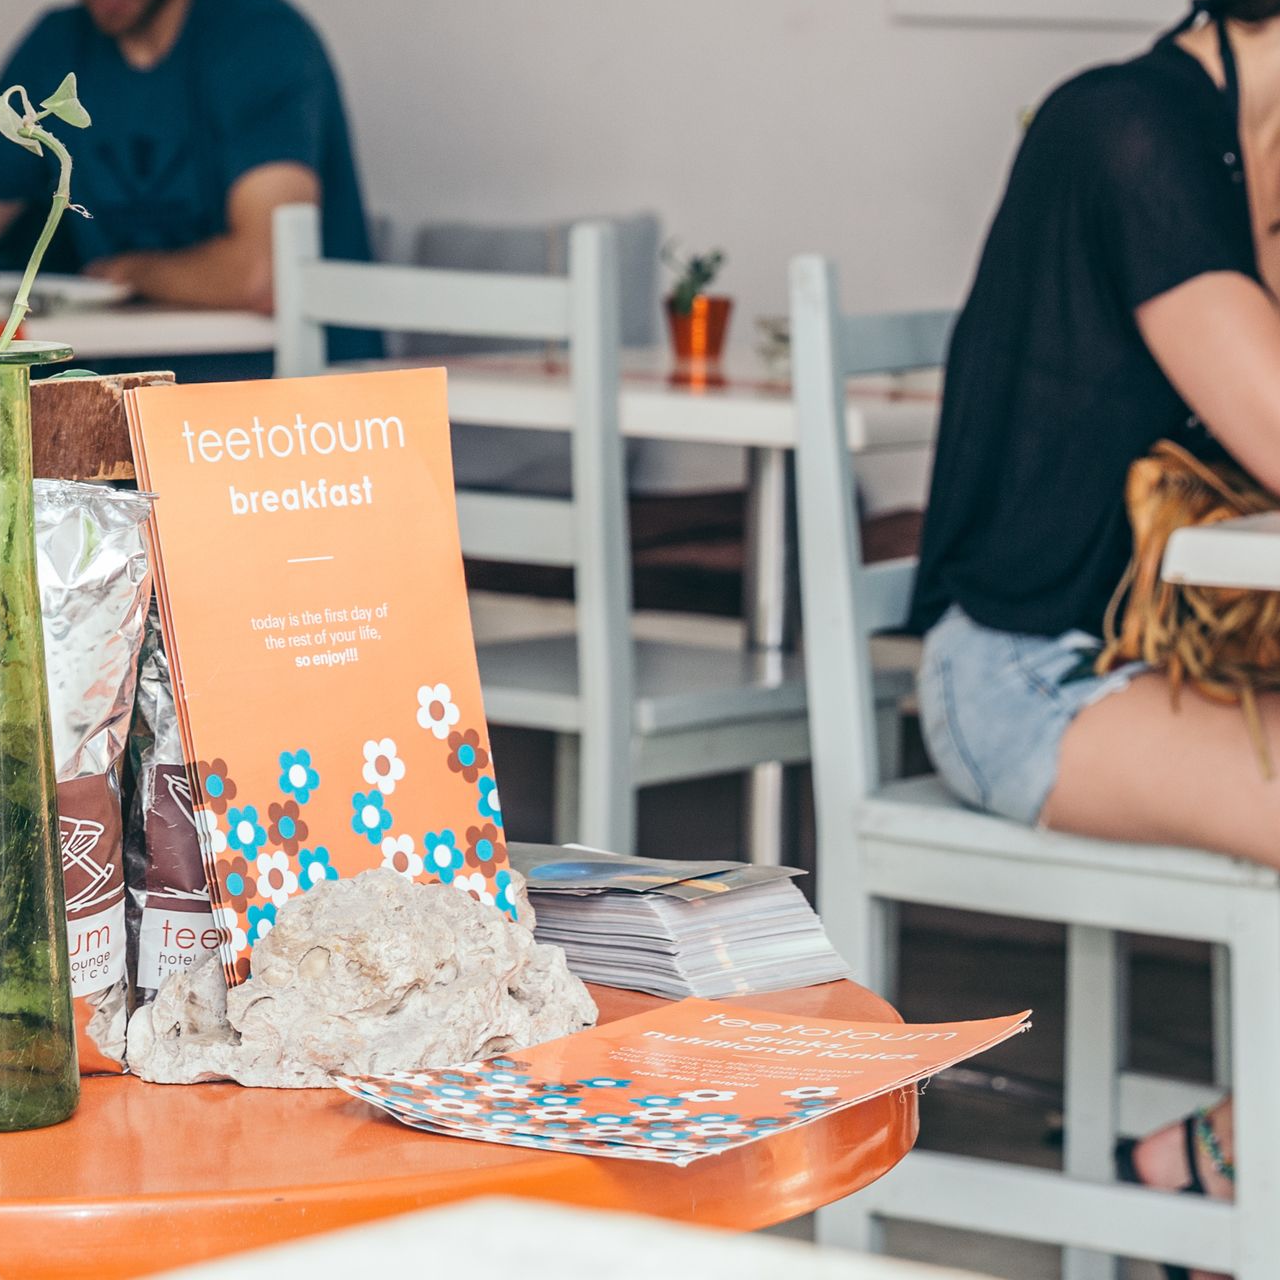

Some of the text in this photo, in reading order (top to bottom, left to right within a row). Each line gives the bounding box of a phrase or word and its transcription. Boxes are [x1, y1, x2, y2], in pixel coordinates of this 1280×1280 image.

[181, 413, 405, 463] teetotoum
[228, 475, 373, 514] breakfast
[250, 602, 389, 630] today is the first day of
[264, 624, 381, 649] the rest of your life,
[295, 647, 359, 667] so enjoy!!!
[701, 1013, 958, 1041] teetotoum
[641, 1030, 919, 1061] nutritional tonics
[743, 1034, 864, 1051] drinks/
[630, 1070, 670, 1078] have
